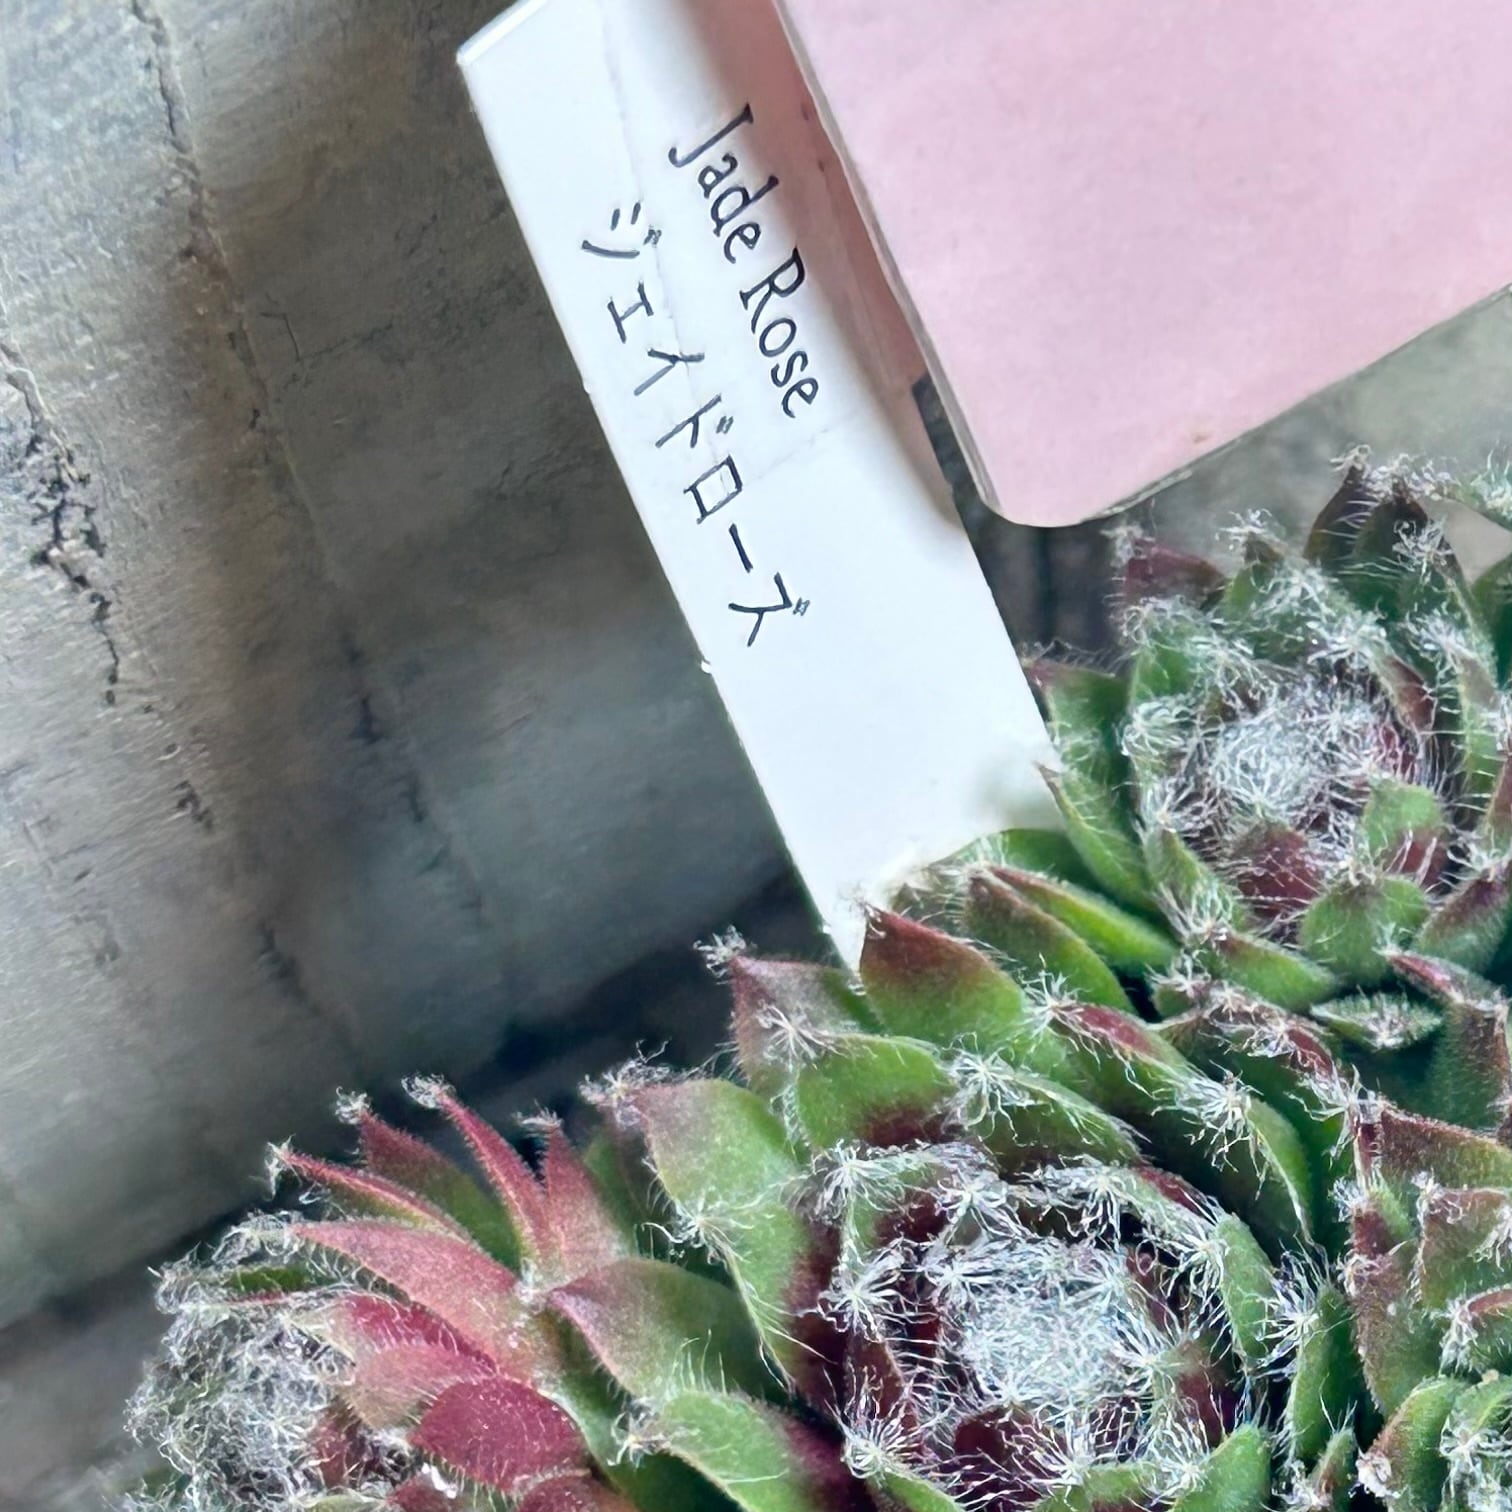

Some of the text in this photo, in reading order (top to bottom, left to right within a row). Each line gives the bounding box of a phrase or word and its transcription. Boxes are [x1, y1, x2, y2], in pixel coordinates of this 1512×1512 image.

[581, 202, 810, 647] ジェイドローズ
[668, 103, 818, 418] Jade Rose
